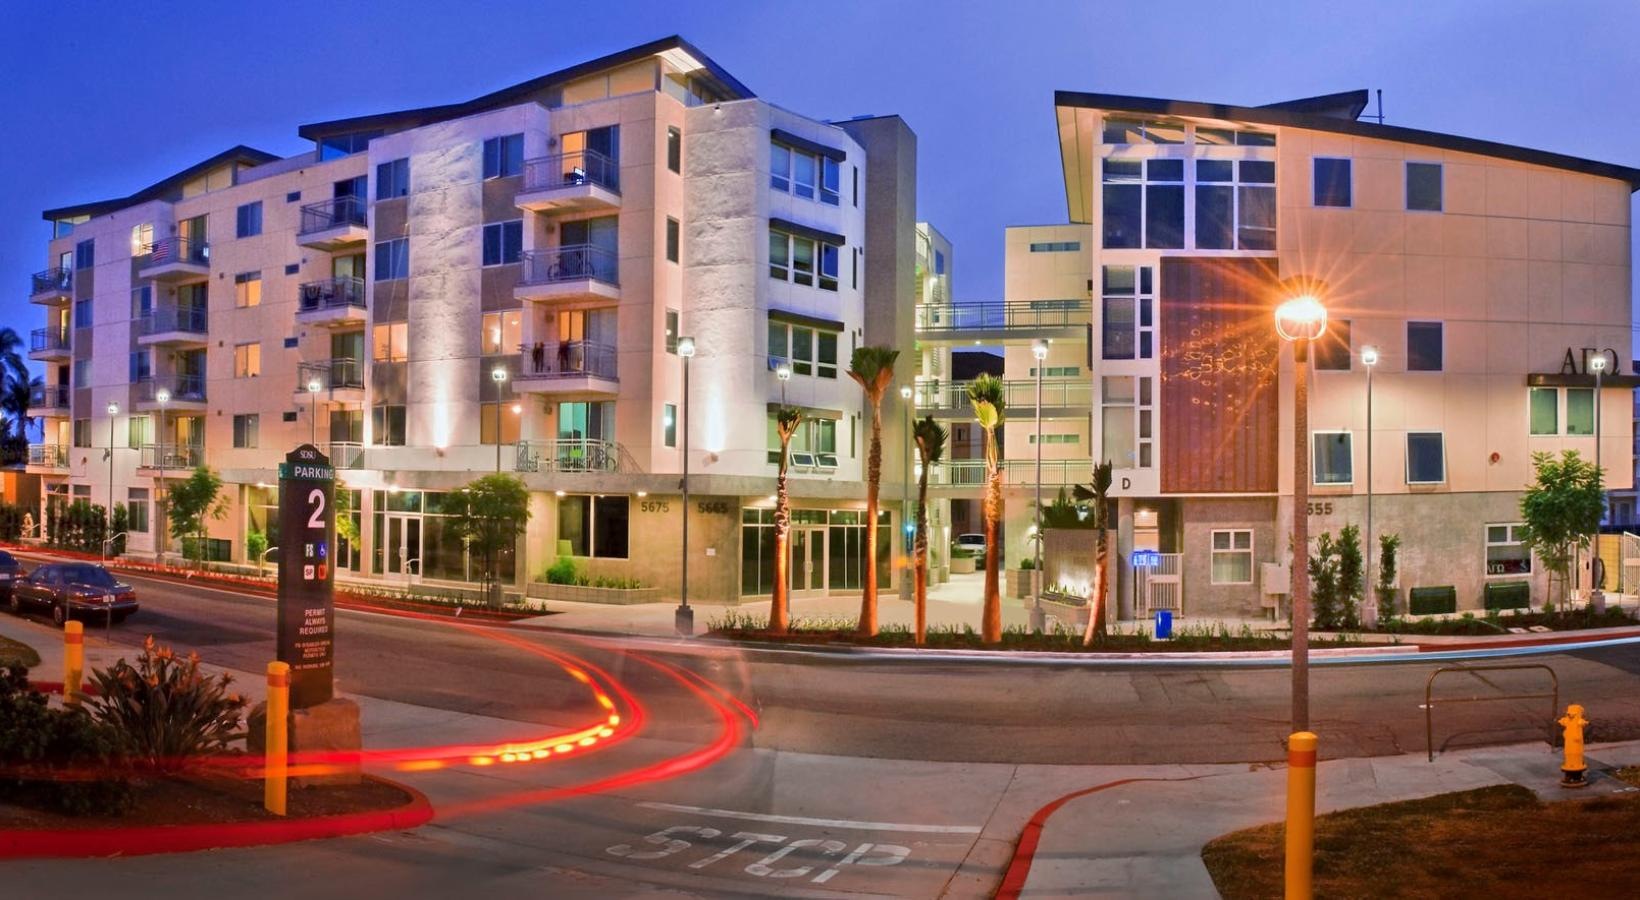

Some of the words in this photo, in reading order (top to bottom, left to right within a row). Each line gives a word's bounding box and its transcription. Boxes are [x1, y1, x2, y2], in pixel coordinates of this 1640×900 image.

[294, 466, 334, 479] PARKING
[1122, 478, 1131, 490] D
[308, 488, 326, 528] 2
[641, 501, 670, 513] 5675
[697, 501, 729, 514] 5665
[305, 543, 314, 557] FS
[304, 608, 326, 617] PERMIT
[304, 617, 326, 626] ALWAYS
[299, 625, 329, 635] REQUIRED
